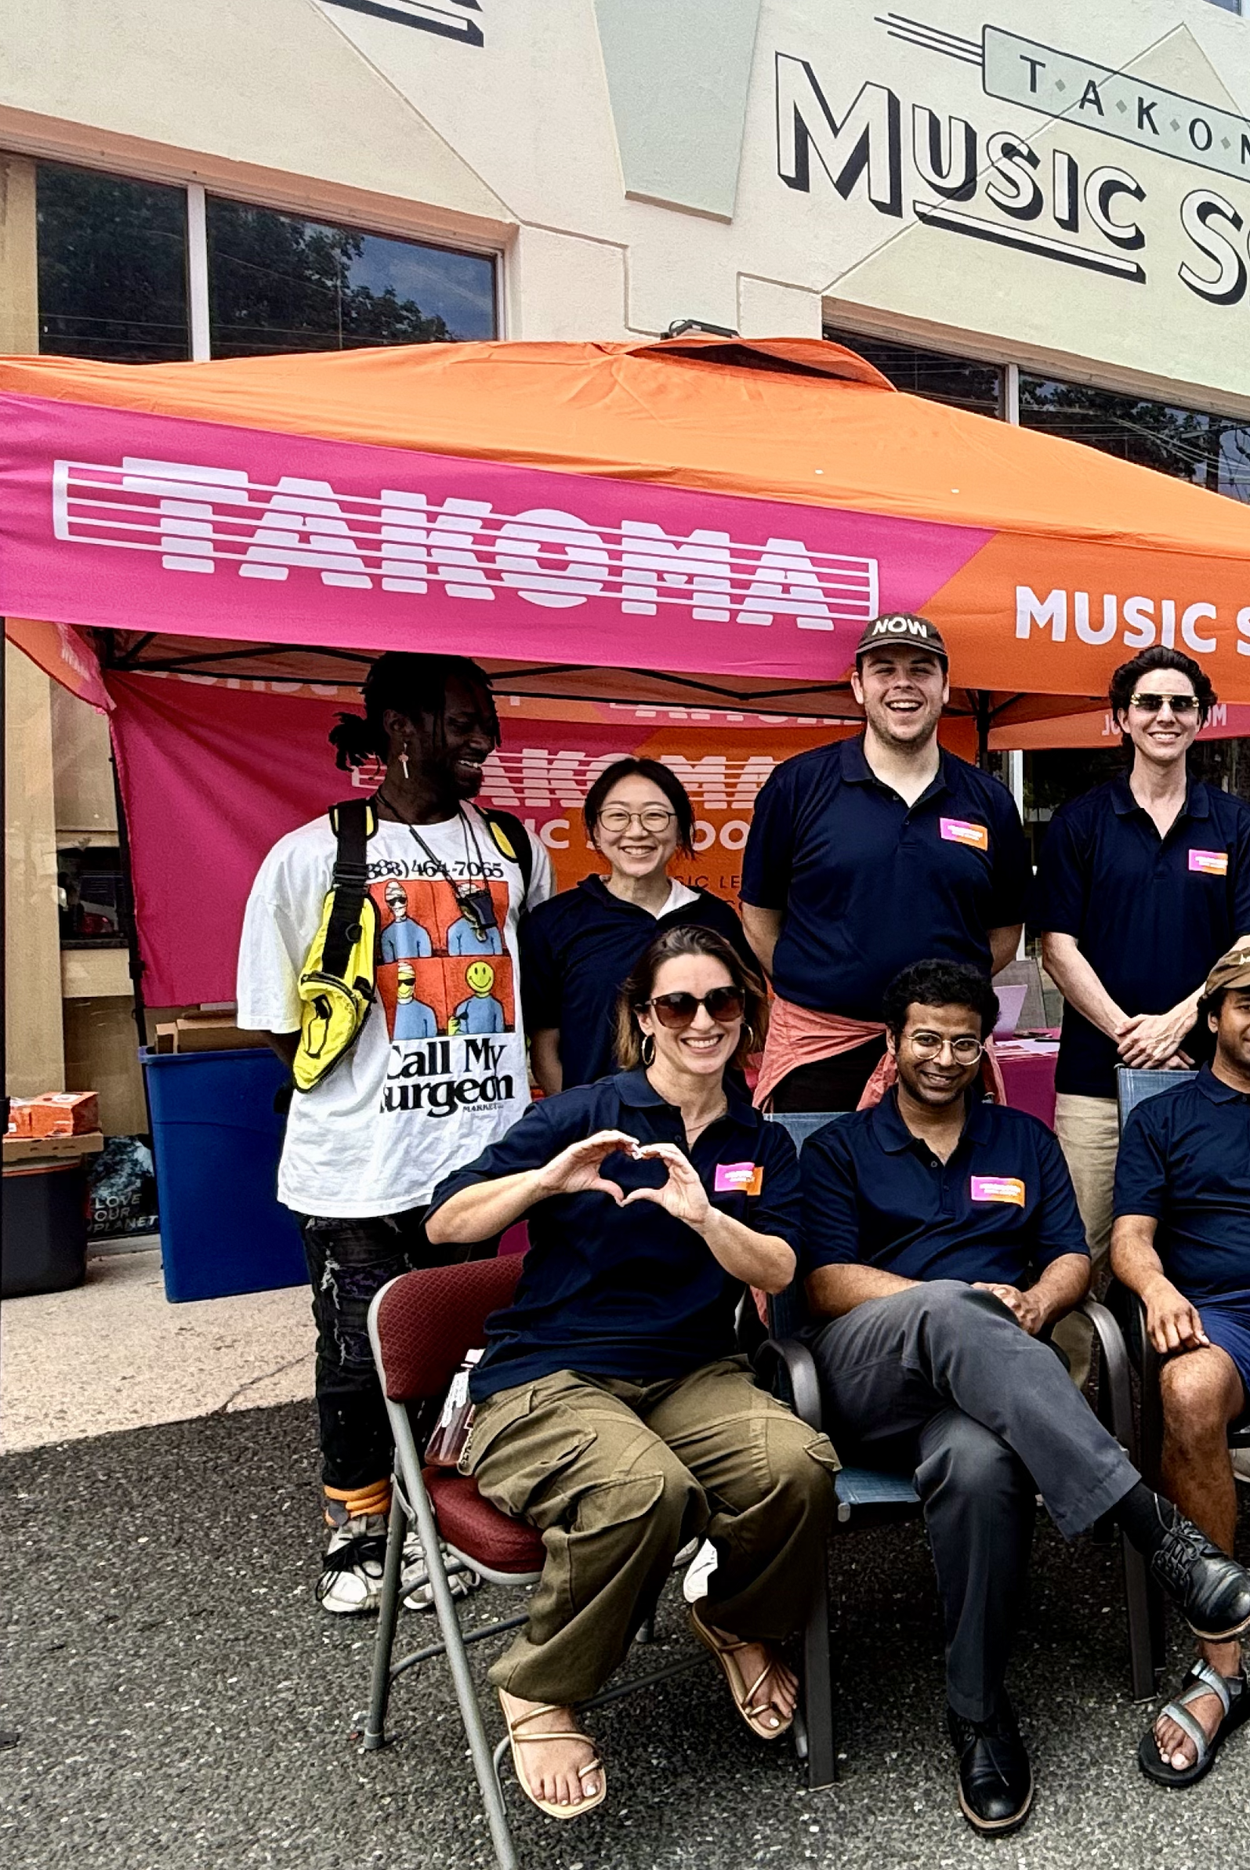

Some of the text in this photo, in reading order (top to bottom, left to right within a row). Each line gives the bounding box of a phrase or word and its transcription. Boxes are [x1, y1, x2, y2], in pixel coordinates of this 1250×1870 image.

[775, 50, 1148, 251] MUSIC
[122, 457, 836, 631] TAKOMA
[872, 616, 928, 638] NOW
[1014, 585, 1217, 655] MUSIC
[463, 1037, 507, 1076] My
[379, 1074, 515, 1118] urgeon
[94, 1207, 130, 1222] OUR
[95, 1194, 142, 1208] LOVE
[93, 1215, 159, 1232] PLANET
